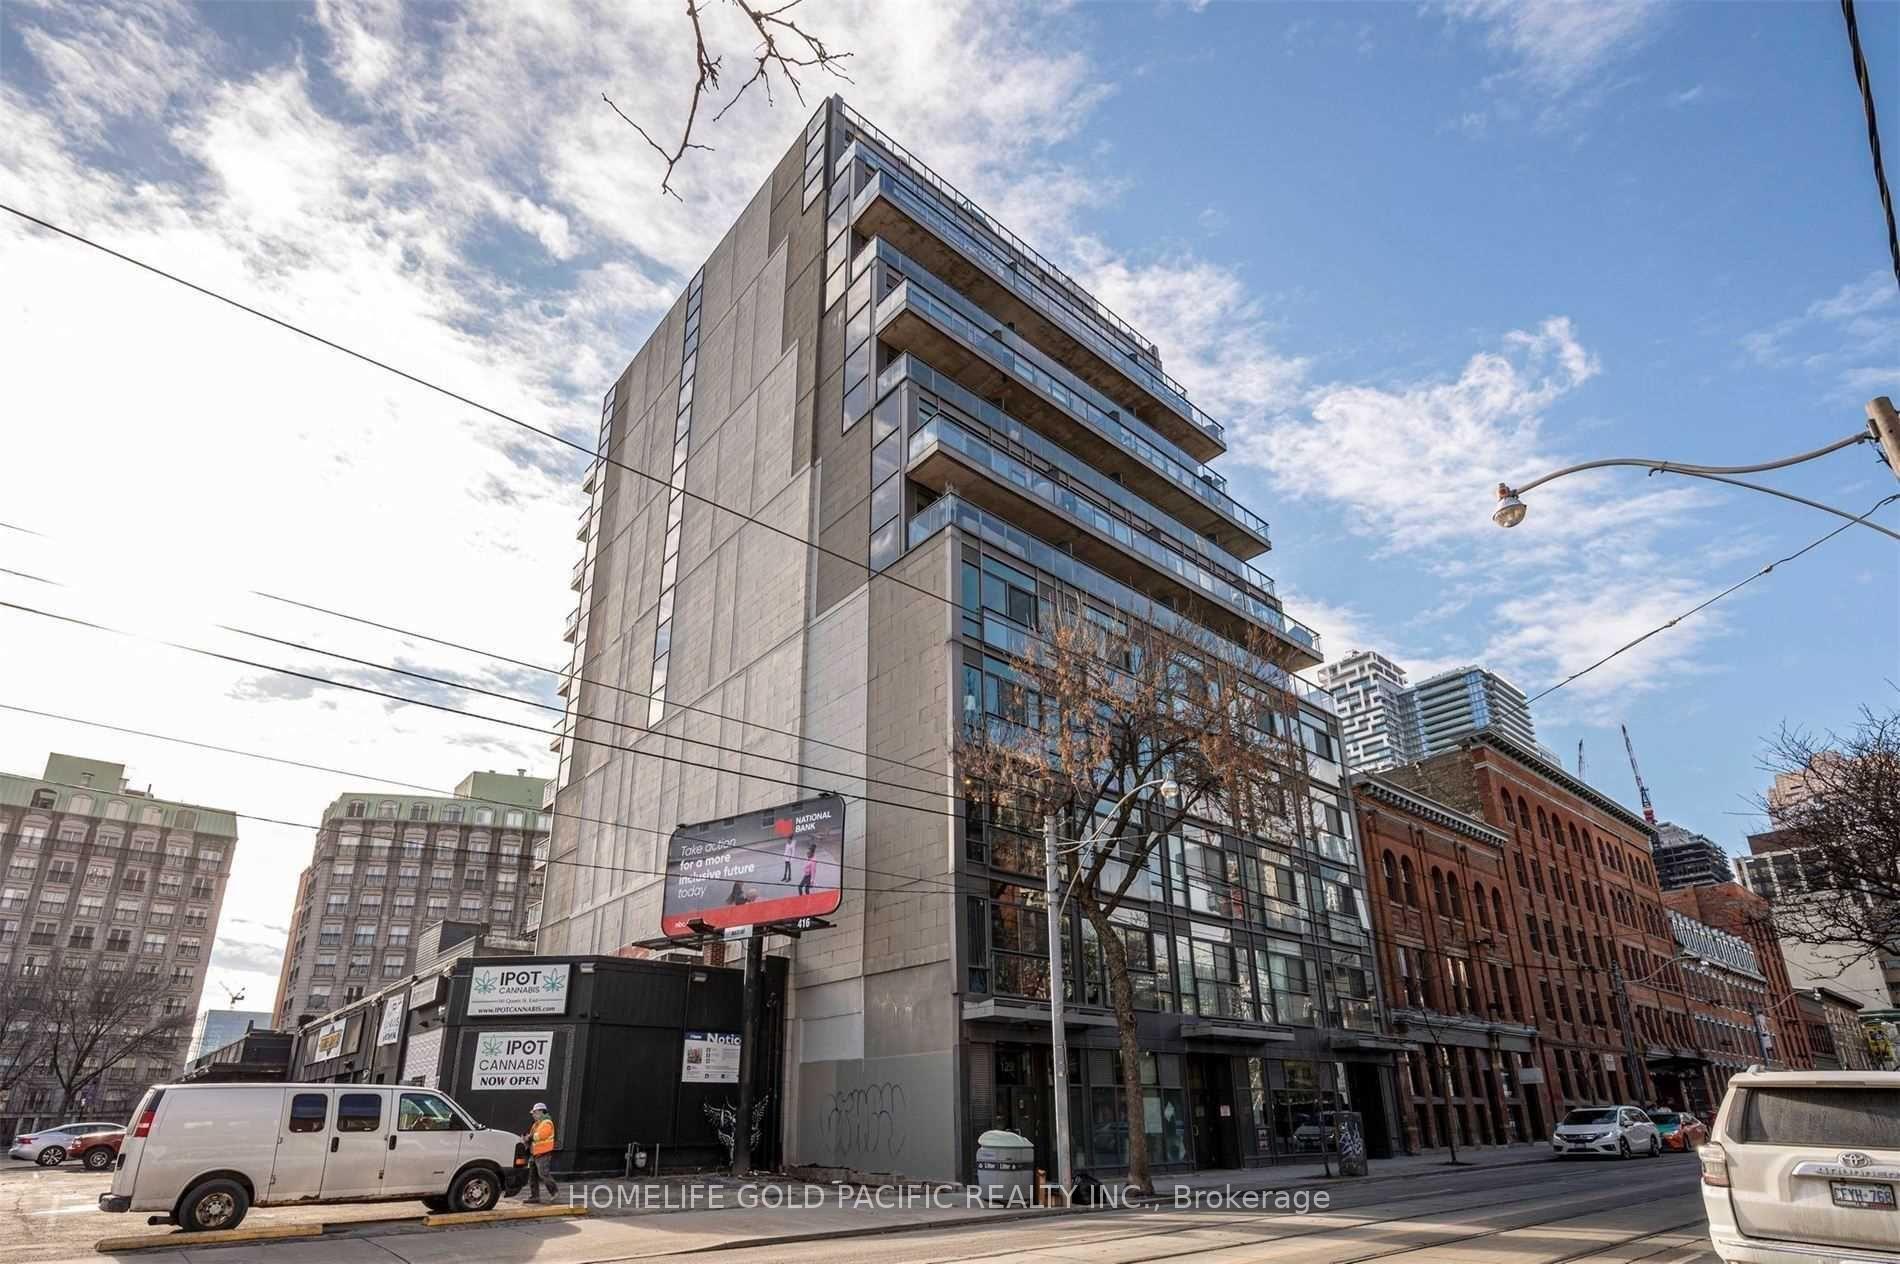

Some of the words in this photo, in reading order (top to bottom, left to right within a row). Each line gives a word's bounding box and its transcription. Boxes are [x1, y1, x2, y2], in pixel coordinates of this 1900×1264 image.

[795, 811, 831, 824] NATIONAL
[795, 822, 815, 833] BANK
[681, 845, 703, 856] Take
[705, 838, 736, 852] action
[680, 860, 693, 871] for
[696, 859, 703, 868] a
[705, 854, 731, 866] more
[679, 869, 721, 885] inclusive
[723, 863, 755, 877] future
[678, 886, 706, 899] today
[500, 971, 542, 986] IPOT
[499, 986, 540, 994] CANNABIS
[707, 1033, 741, 1045] Notic
[506, 1040, 548, 1055] IPOT
[479, 1059, 545, 1071] CANNABIS
[480, 1077, 507, 1086] NOW
[510, 1076, 539, 1086] OPEN
